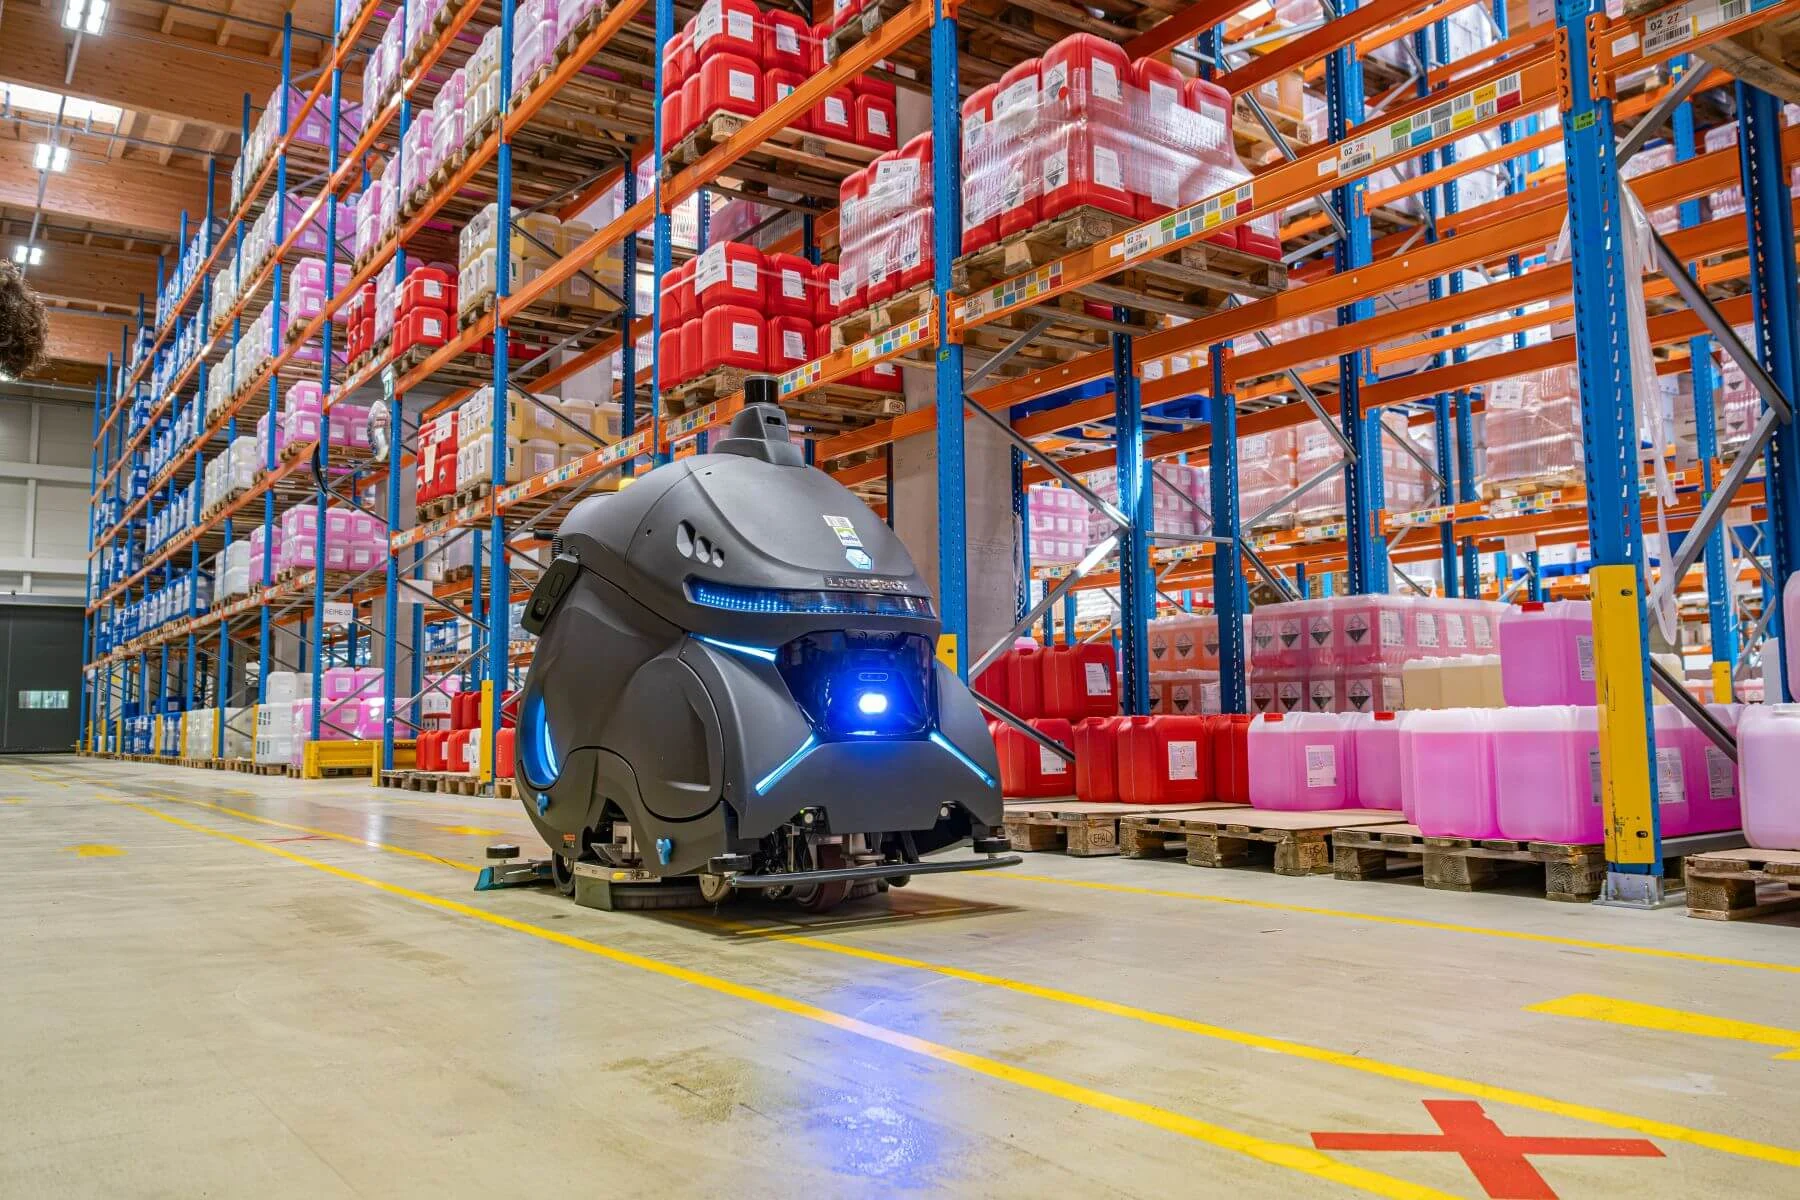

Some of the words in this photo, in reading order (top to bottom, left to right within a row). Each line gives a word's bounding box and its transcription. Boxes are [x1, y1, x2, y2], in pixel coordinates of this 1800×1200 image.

[1650, 19, 1663, 31] 02
[1667, 12, 1679, 24] 27
[1344, 147, 1353, 157] 02
[1093, 833, 1111, 844] EPAL
